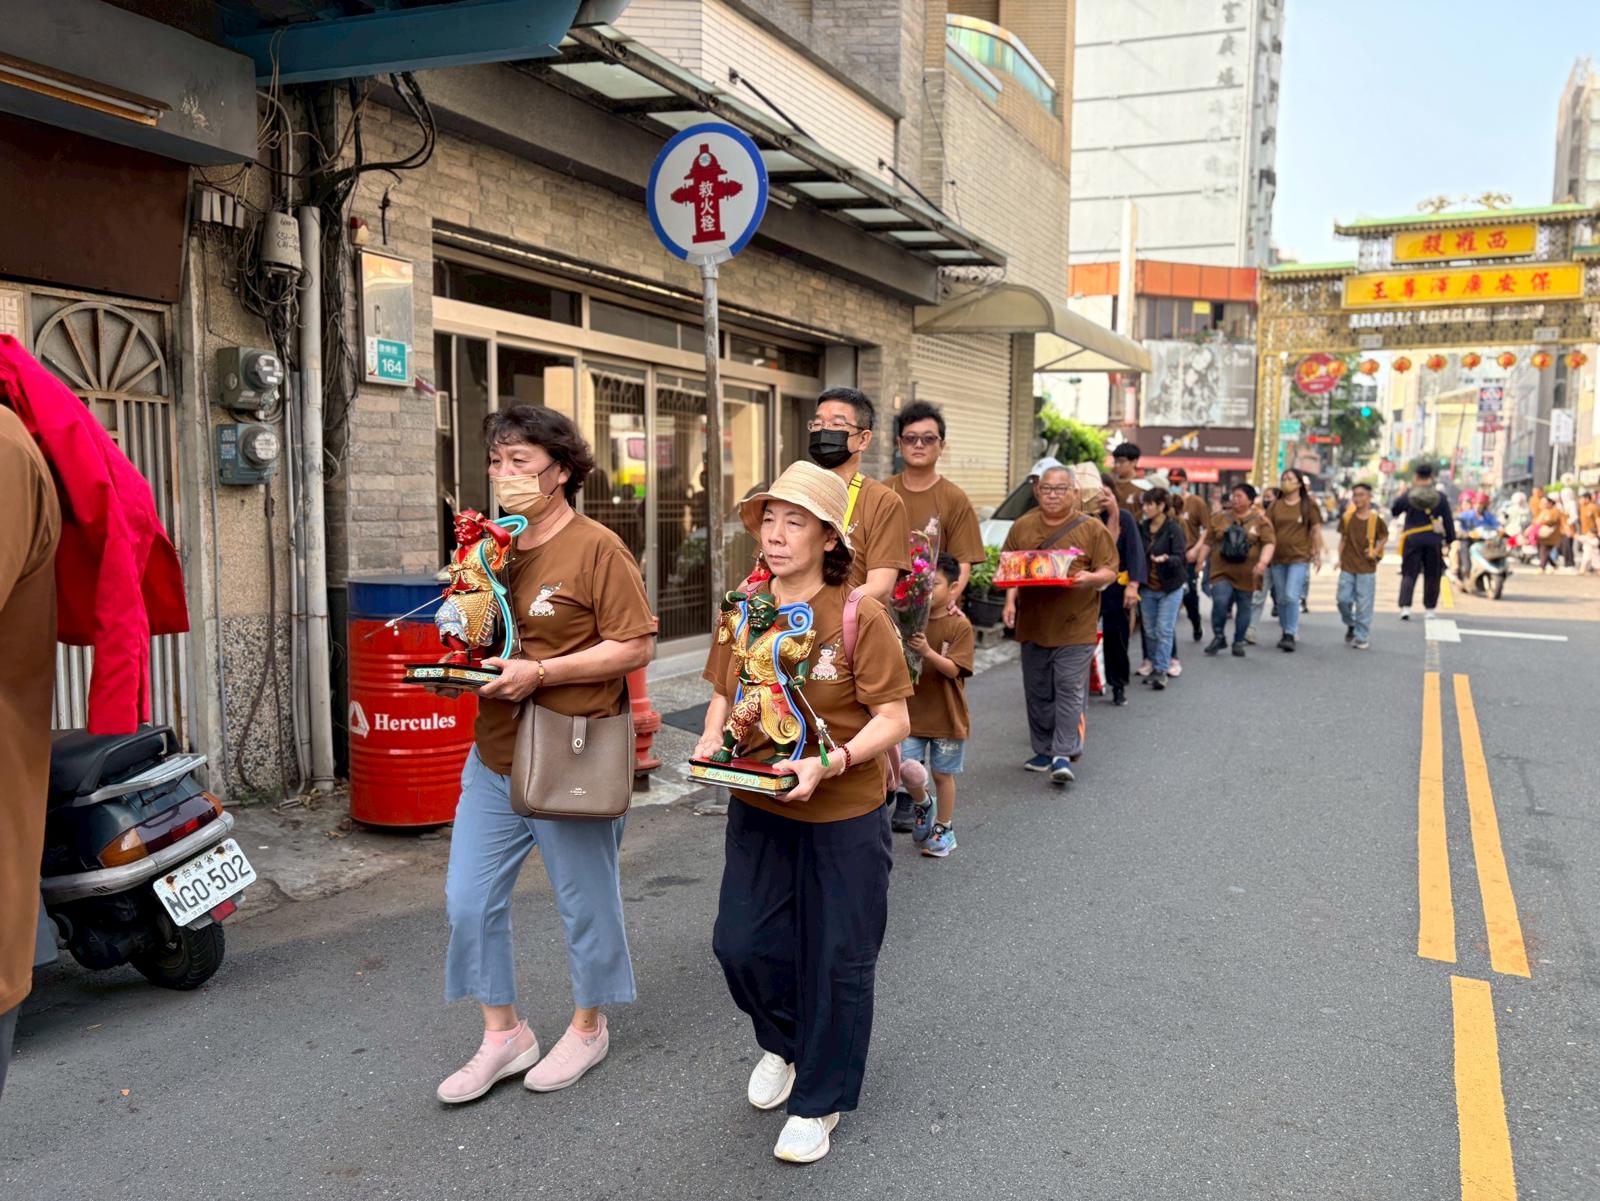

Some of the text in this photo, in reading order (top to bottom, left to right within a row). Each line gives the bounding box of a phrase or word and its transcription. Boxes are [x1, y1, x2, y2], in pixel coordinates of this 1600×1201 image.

[699, 180, 716, 232] 救火栓
[382, 358, 402, 374] 164
[374, 712, 456, 731] Hercules
